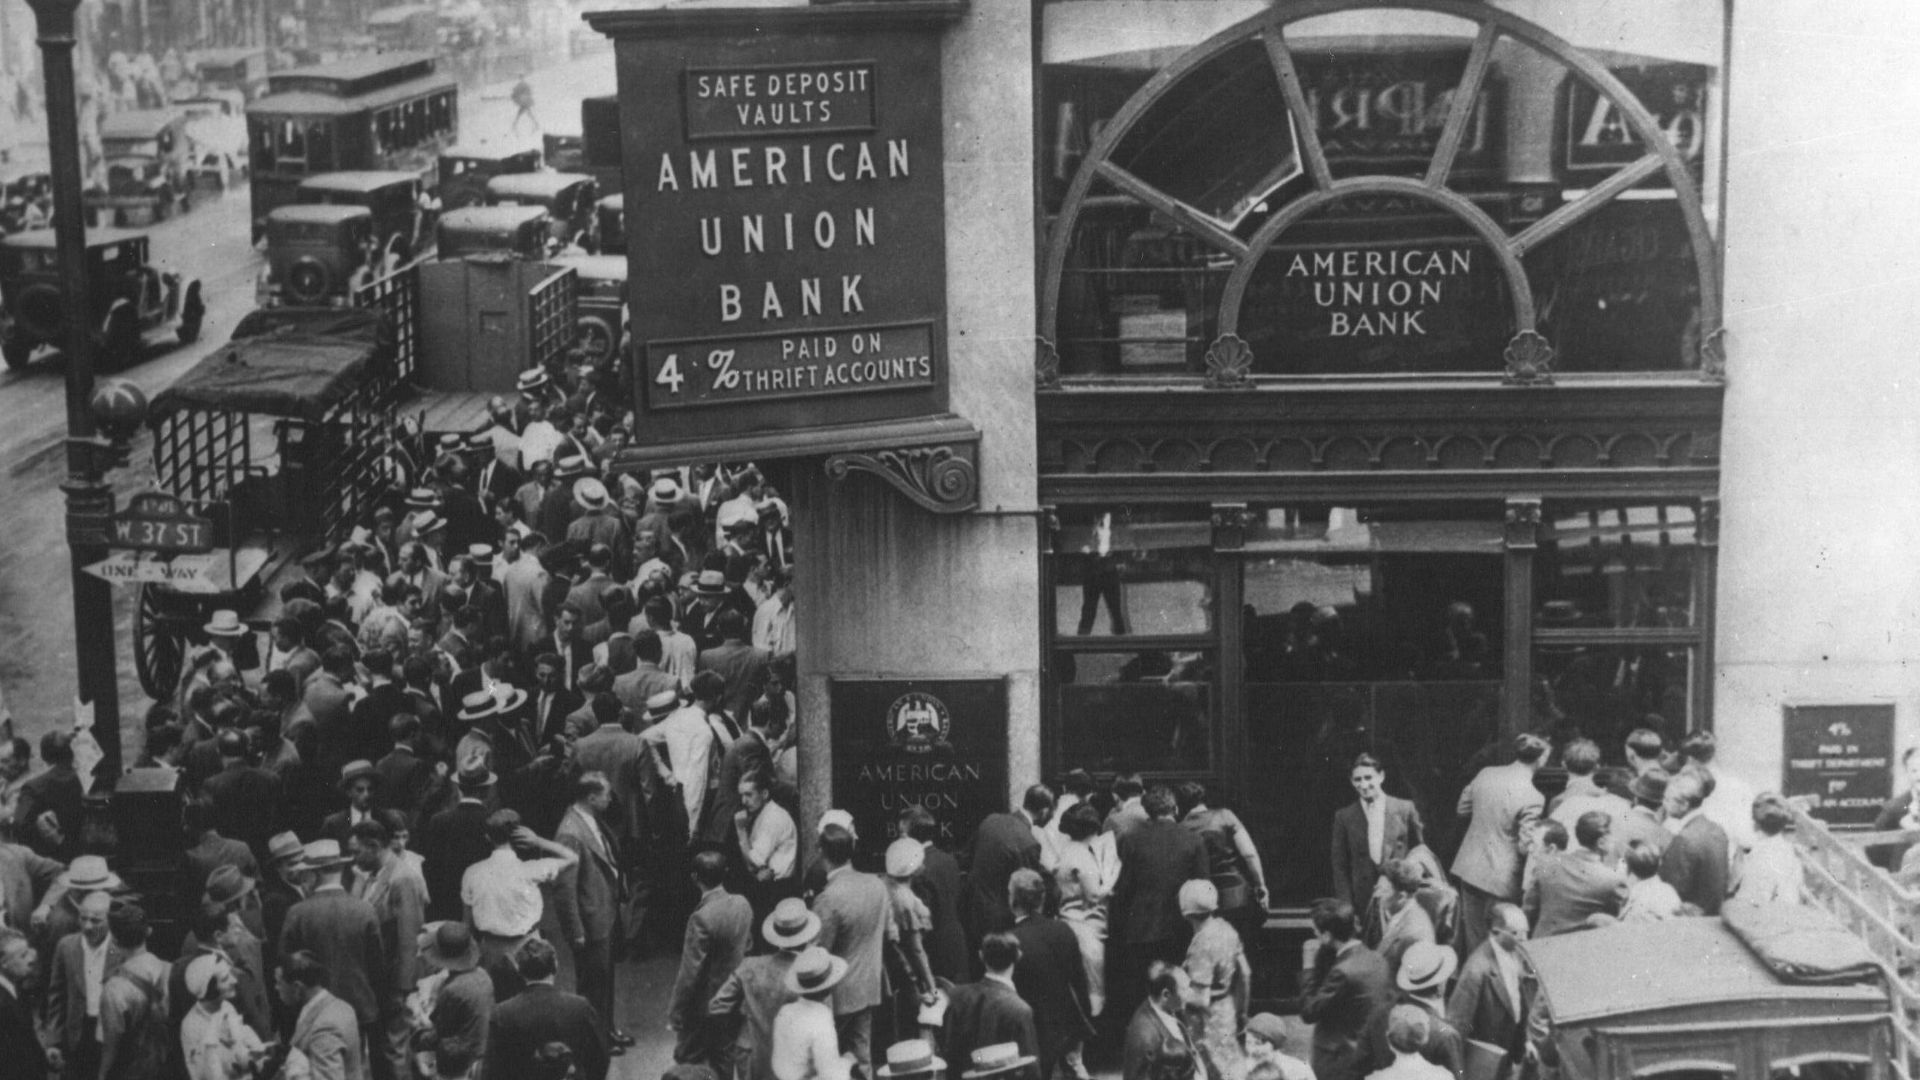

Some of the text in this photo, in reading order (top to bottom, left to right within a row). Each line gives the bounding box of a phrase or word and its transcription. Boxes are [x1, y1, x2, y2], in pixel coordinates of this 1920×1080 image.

[699, 70, 868, 97] SAFE DEPOSIT
[737, 101, 830, 125] VAULTS
[658, 140, 909, 191] AMERICAN
[701, 208, 875, 255] UNION
[1287, 250, 1470, 278] AMERICAN
[720, 275, 863, 322] BANK
[1315, 281, 1441, 306] UNION
[1330, 310, 1426, 336] BANK
[782, 333, 880, 360] PAID ON
[744, 356, 930, 391] THRIFT ACCOUNTS
[115, 521, 201, 546] W 37 ST
[859, 763, 980, 782] AMERICAN
[886, 821, 953, 838] BK
